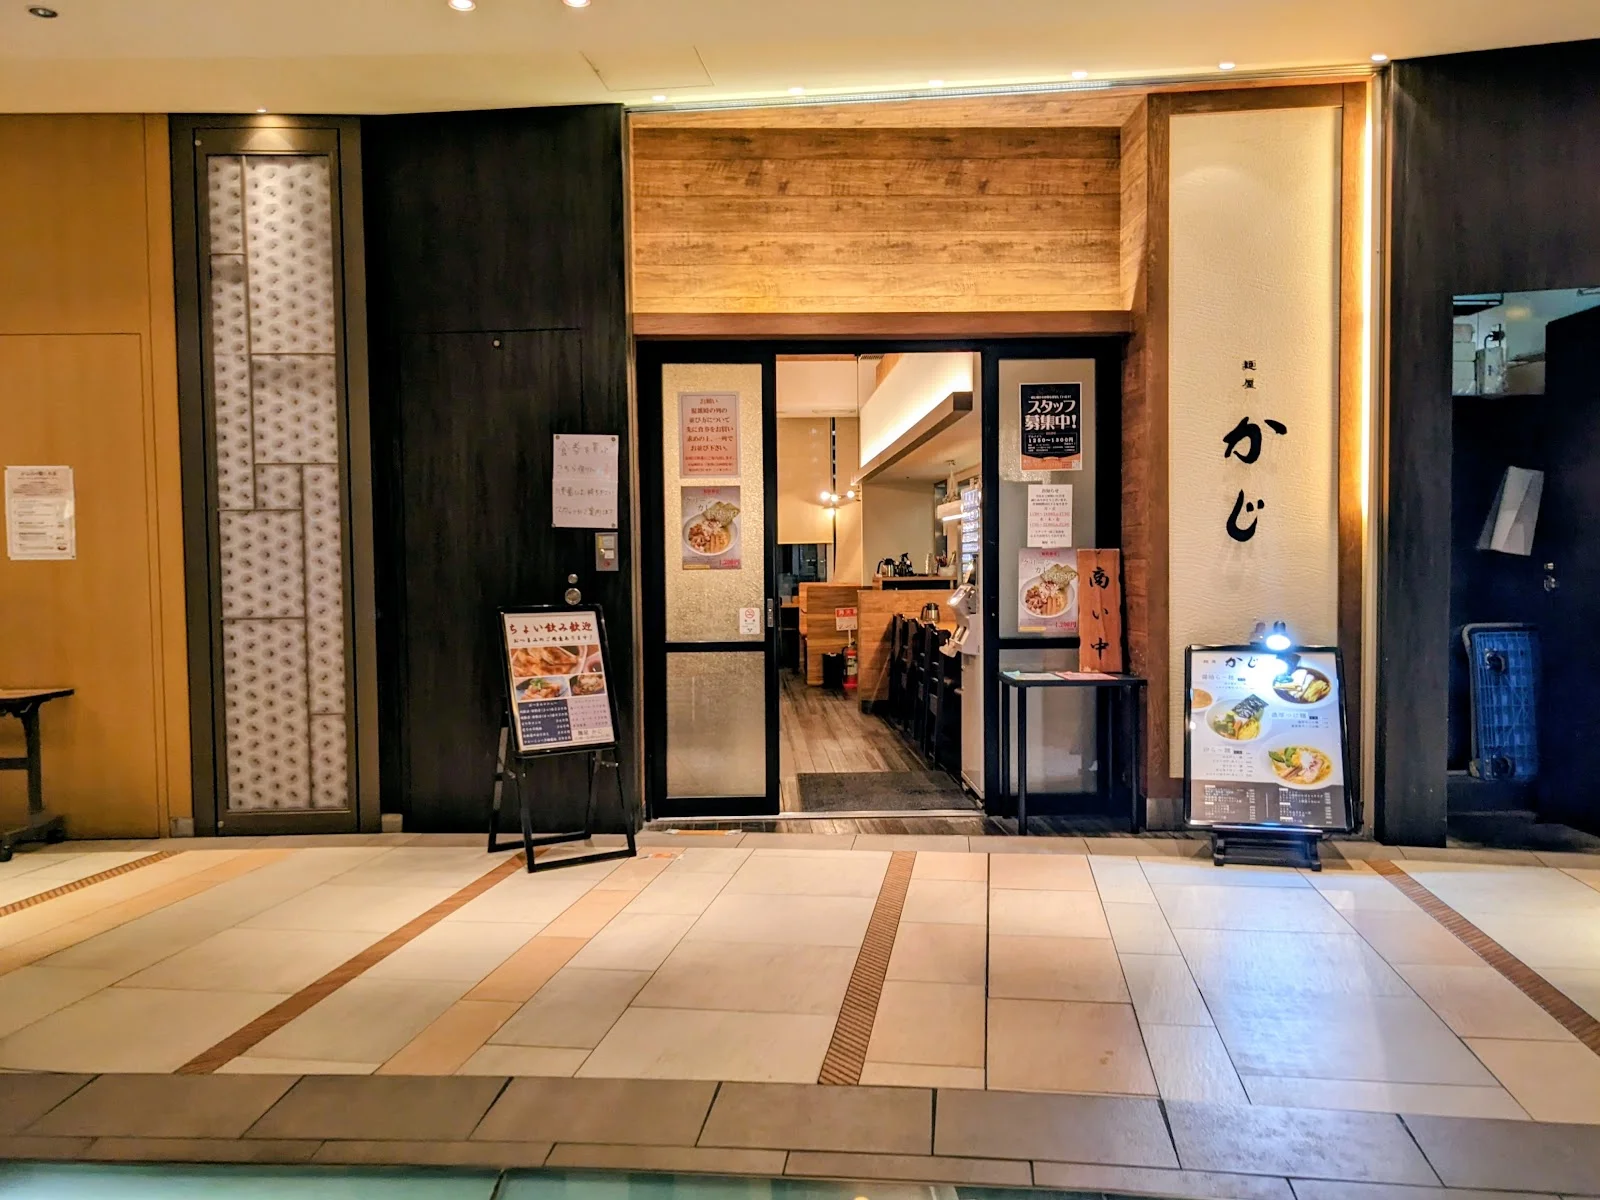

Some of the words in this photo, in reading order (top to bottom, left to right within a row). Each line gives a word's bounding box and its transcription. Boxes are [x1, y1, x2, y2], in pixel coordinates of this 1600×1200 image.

[1028, 400, 1076, 413] スタッフ
[1025, 415, 1077, 430] 募集中!
[1223, 416, 1287, 542] かじ
[1089, 566, 1110, 661] 商い中
[509, 621, 593, 634] ちょい飲み歓迎
[1225, 656, 1258, 668] かじ
